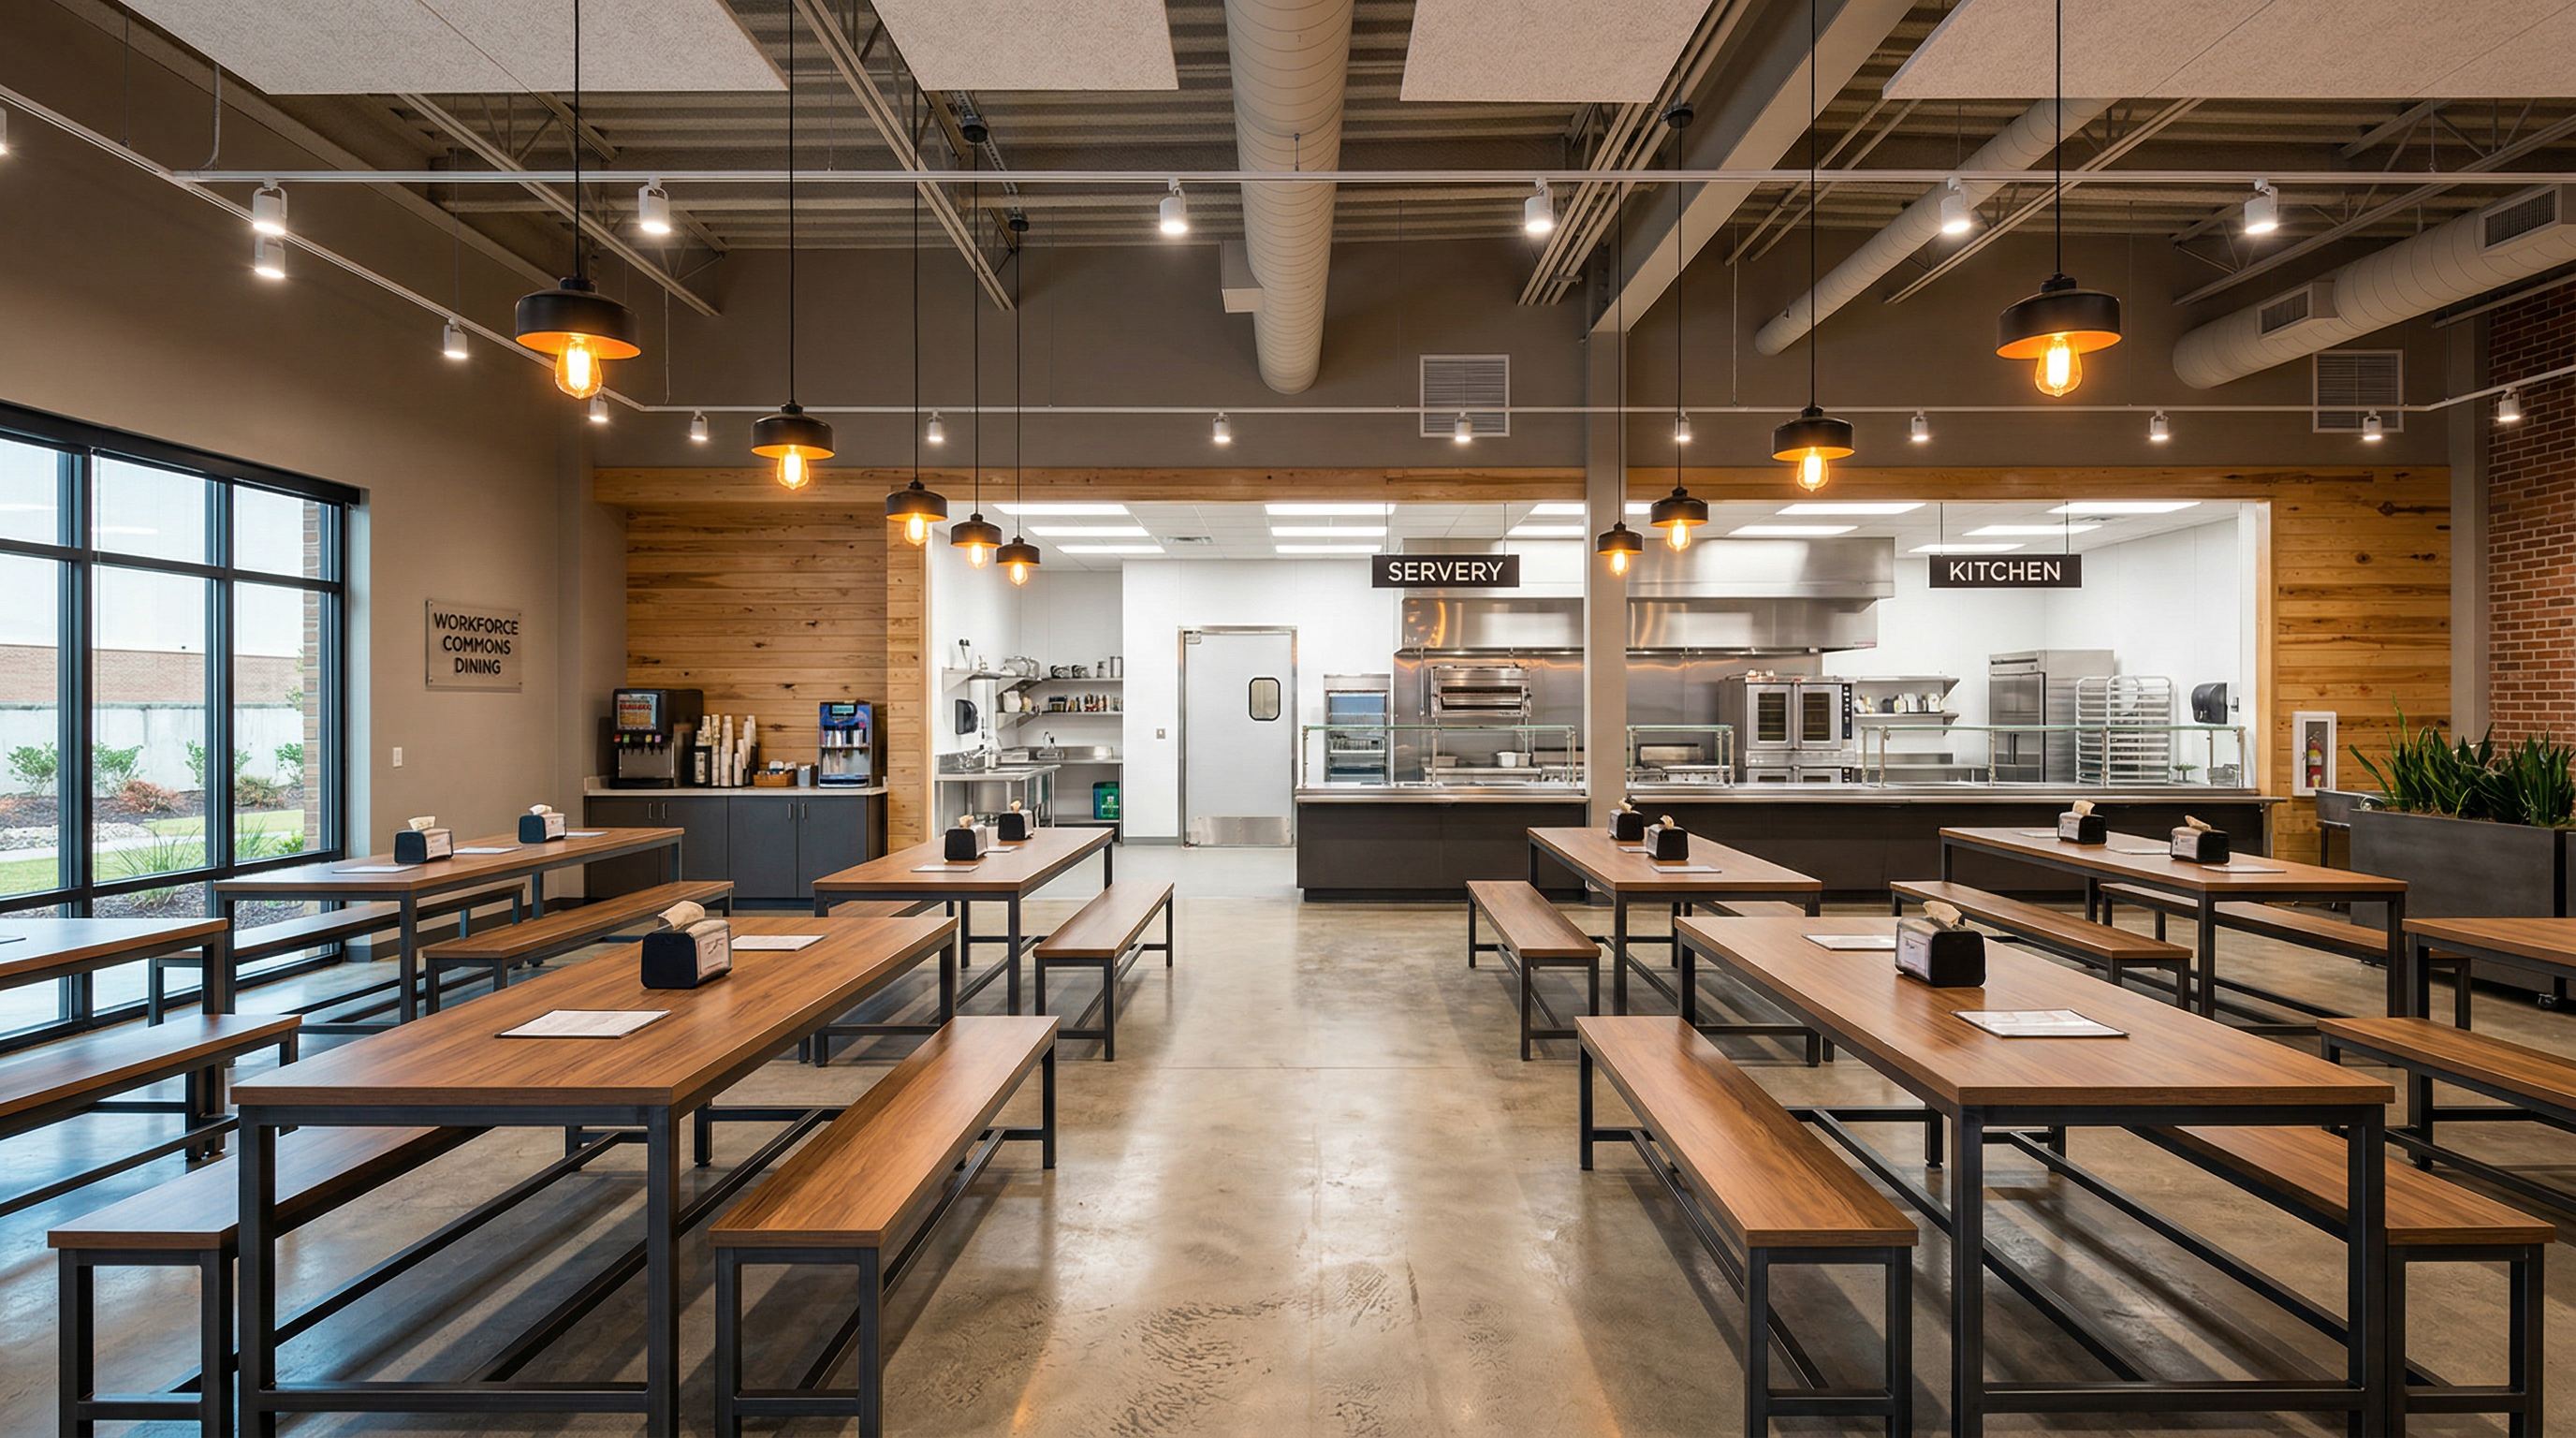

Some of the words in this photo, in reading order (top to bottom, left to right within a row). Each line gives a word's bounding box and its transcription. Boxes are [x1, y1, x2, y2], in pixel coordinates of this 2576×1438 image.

[1388, 562, 1503, 581] SERVERY
[1950, 561, 2061, 581] KITCHEN
[433, 612, 519, 636] WORKFORCE
[443, 635, 511, 655] COMMONS
[455, 657, 501, 674] DINING
